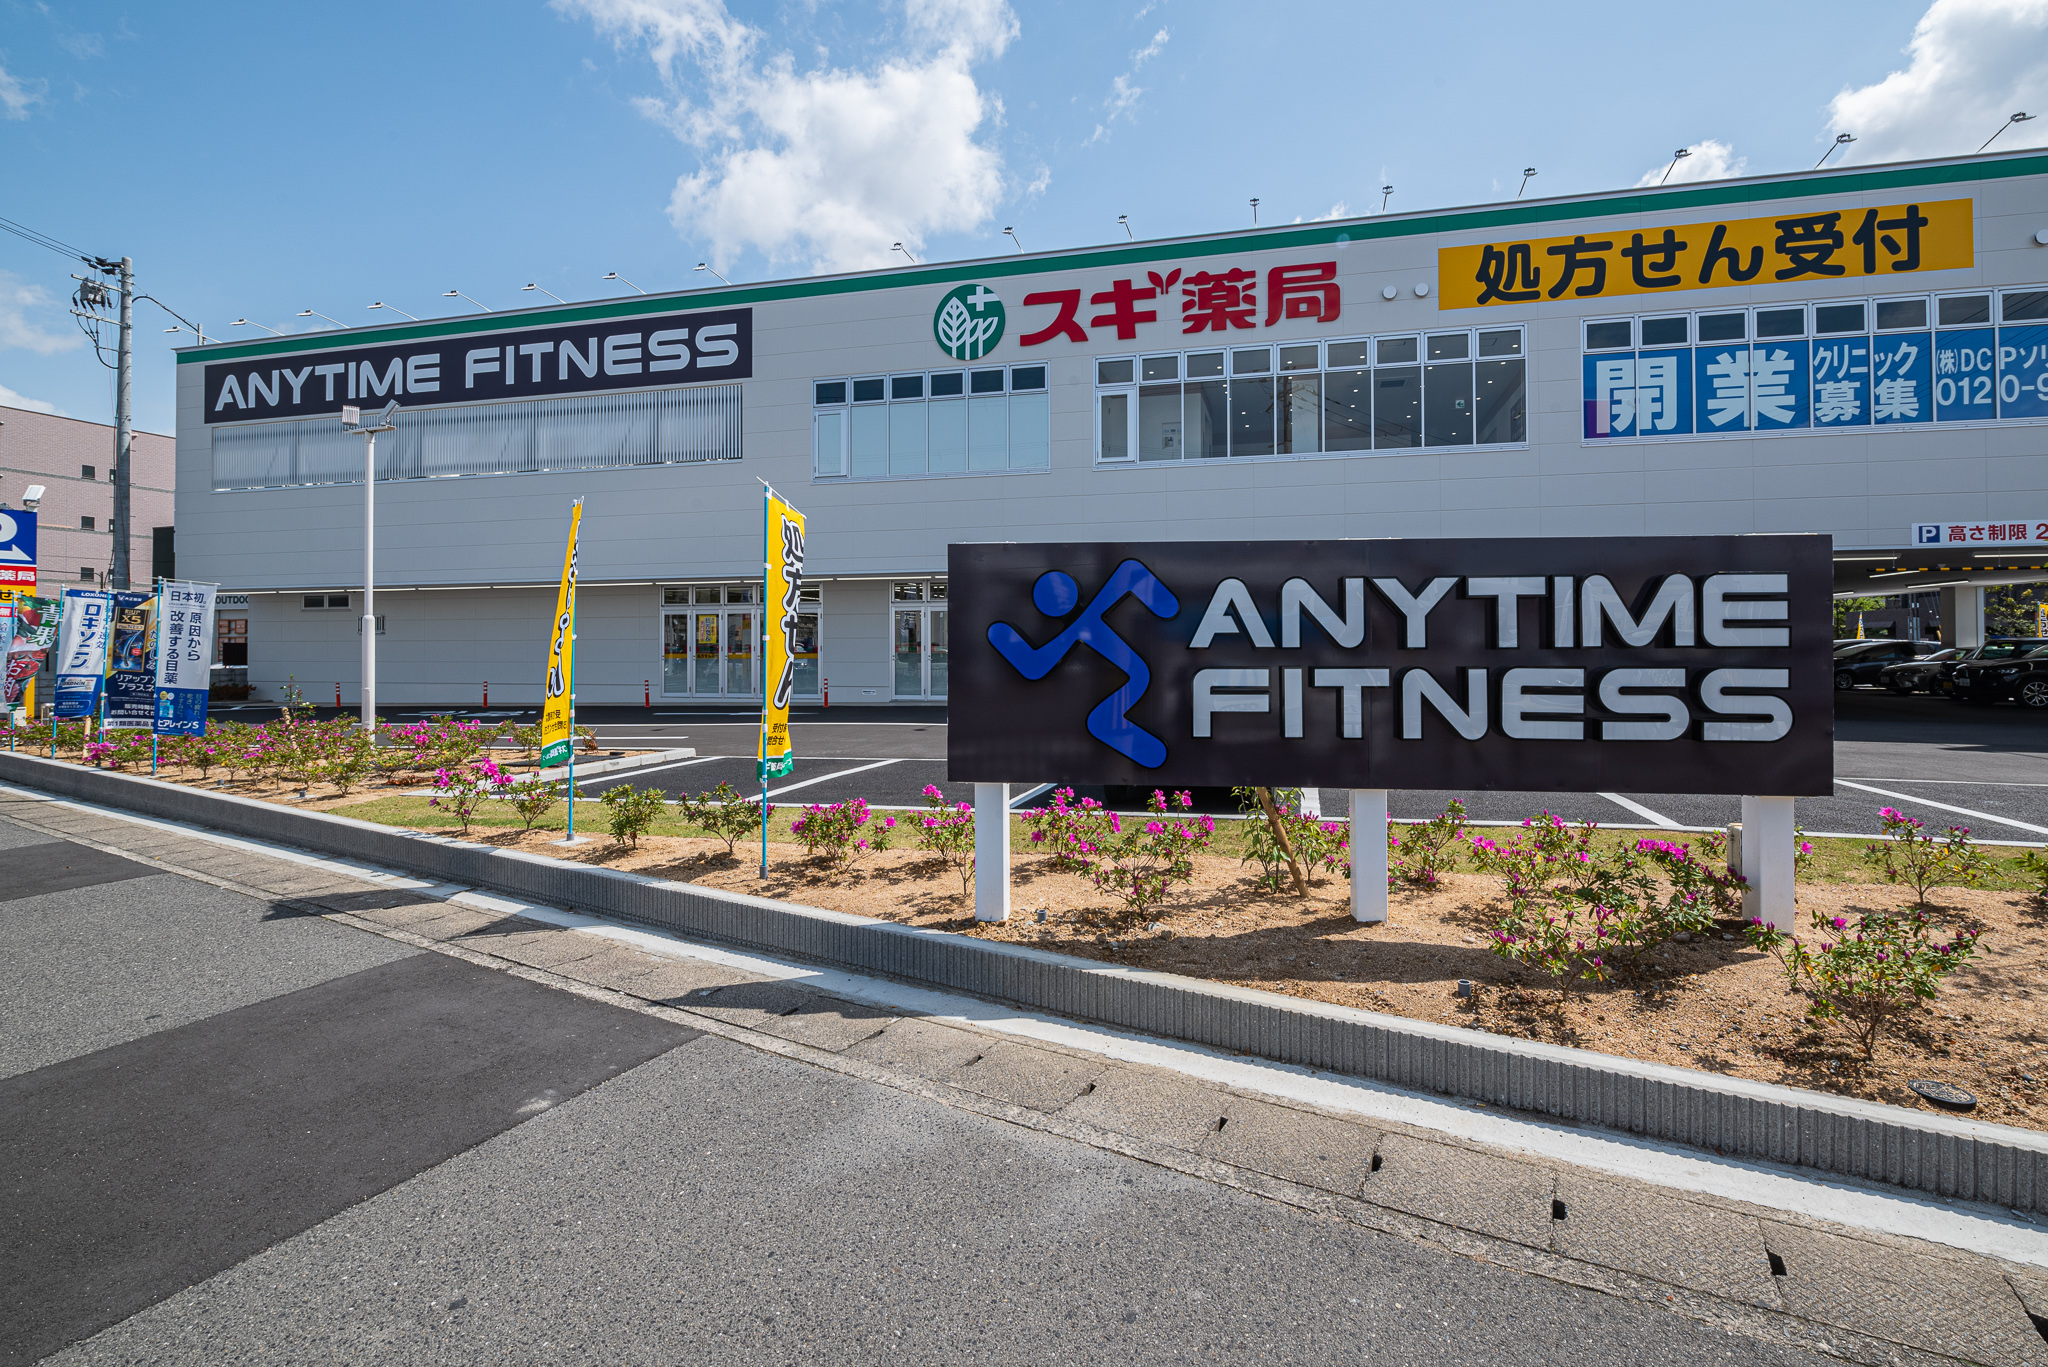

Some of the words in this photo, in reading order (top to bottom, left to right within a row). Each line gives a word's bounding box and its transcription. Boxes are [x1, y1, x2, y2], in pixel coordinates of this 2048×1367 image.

[1475, 204, 1929, 306] 処方せん受付
[1019, 261, 1342, 347] スギ薬局
[214, 352, 440, 411] ANYTIME
[465, 323, 740, 388] FITNESS
[1813, 341, 1917, 380] クリニック
[1596, 348, 1796, 434] 開業
[1815, 377, 1920, 422] 募集
[1922, 526, 1937, 543] P
[1948, 523, 2027, 542] 高さ制限
[121, 614, 142, 624] X5
[171, 591, 206, 605] 日本初。
[1188, 572, 1791, 650] ANYTIME
[27, 604, 60, 646] 青果
[70, 603, 102, 669] ロキソニン
[164, 610, 185, 685] 改善する目薬
[187, 612, 202, 661] 原因から
[4, 659, 25, 697] お肉
[157, 719, 199, 729] ヒアレインS
[1191, 666, 1793, 742] FITNESS
